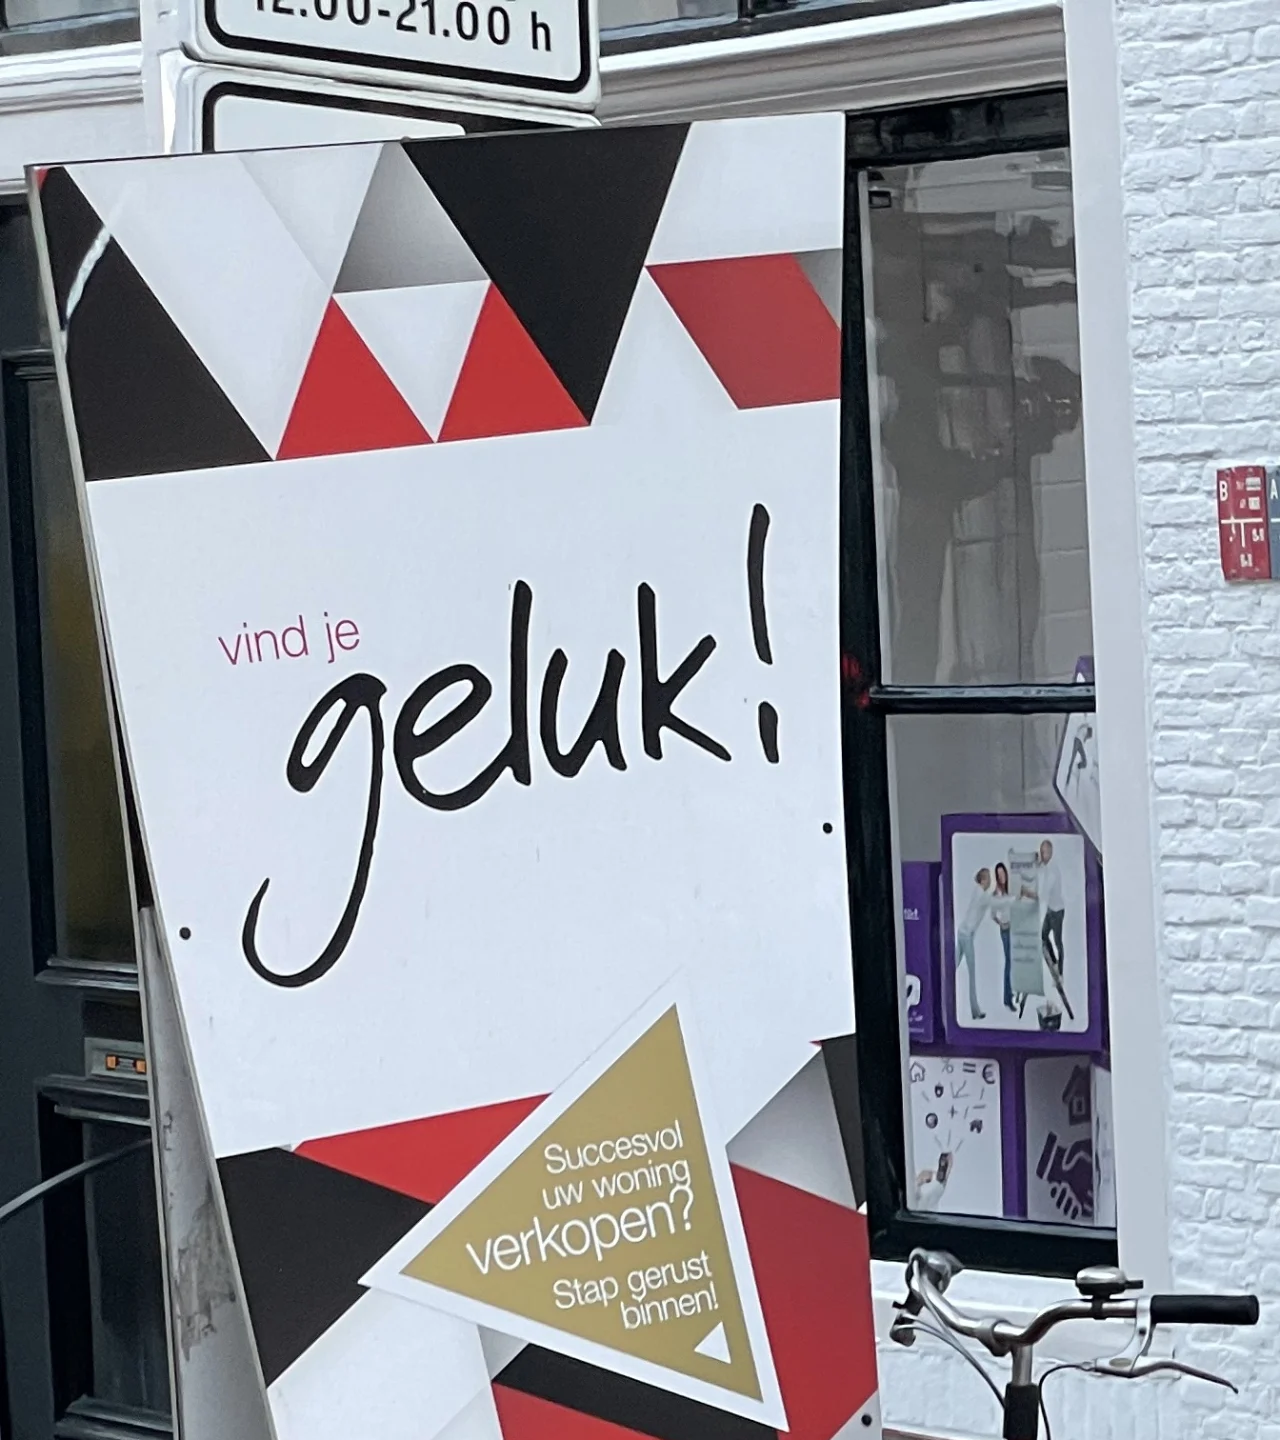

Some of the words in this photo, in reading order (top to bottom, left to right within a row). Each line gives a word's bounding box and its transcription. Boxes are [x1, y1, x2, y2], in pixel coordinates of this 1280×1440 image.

[257, 0, 511, 46] .00-21.00
[532, 11, 552, 52] h
[218, 615, 308, 665] vind
[323, 611, 360, 663] je
[242, 503, 780, 988] geluk!
[544, 1119, 684, 1174] Succesvol
[542, 1180, 584, 1210] uw
[591, 1159, 691, 1199] woning
[466, 1185, 695, 1275] verkopen?
[553, 1276, 619, 1309] Stap
[627, 1250, 713, 1302] gerust
[621, 1281, 719, 1330] binnen!
